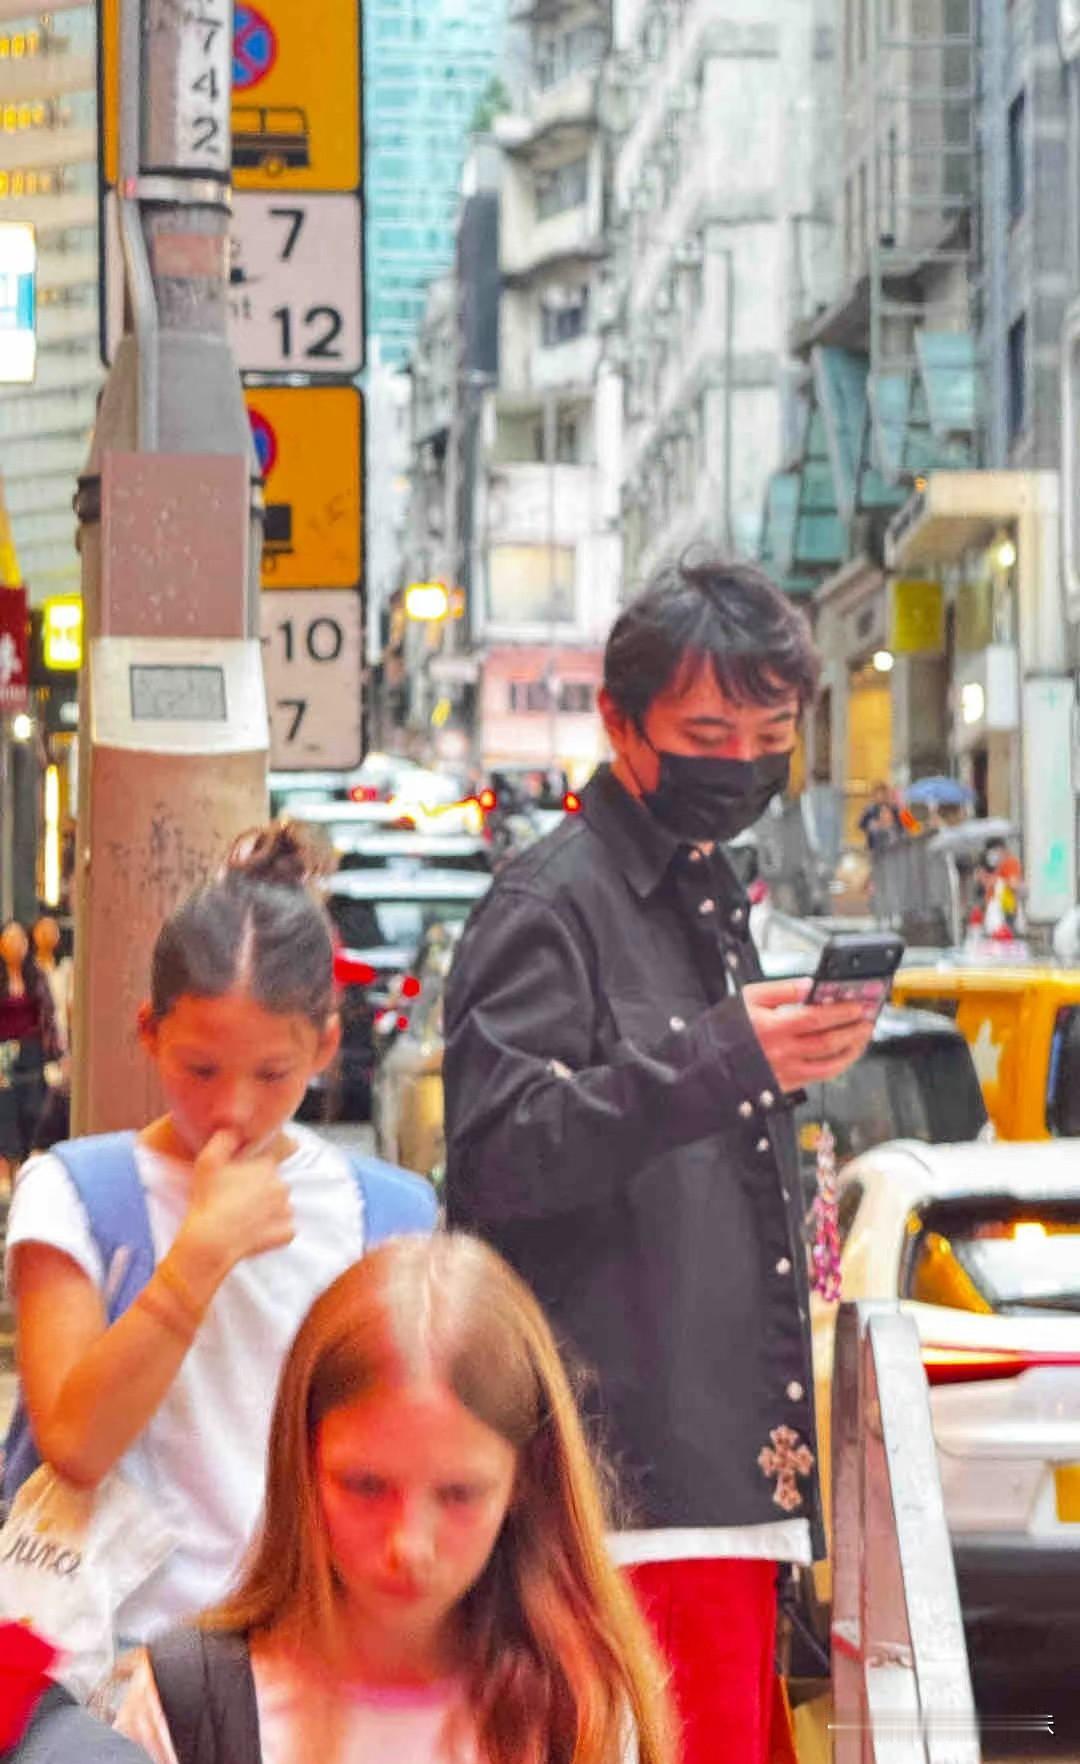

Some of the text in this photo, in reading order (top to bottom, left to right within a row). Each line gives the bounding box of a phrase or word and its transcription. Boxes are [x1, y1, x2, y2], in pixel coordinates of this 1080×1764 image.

[191, 0, 223, 154] 742
[268, 208, 305, 262] 7
[272, 305, 344, 359] 12
[277, 617, 343, 663] 10
[277, 700, 307, 742] 7
